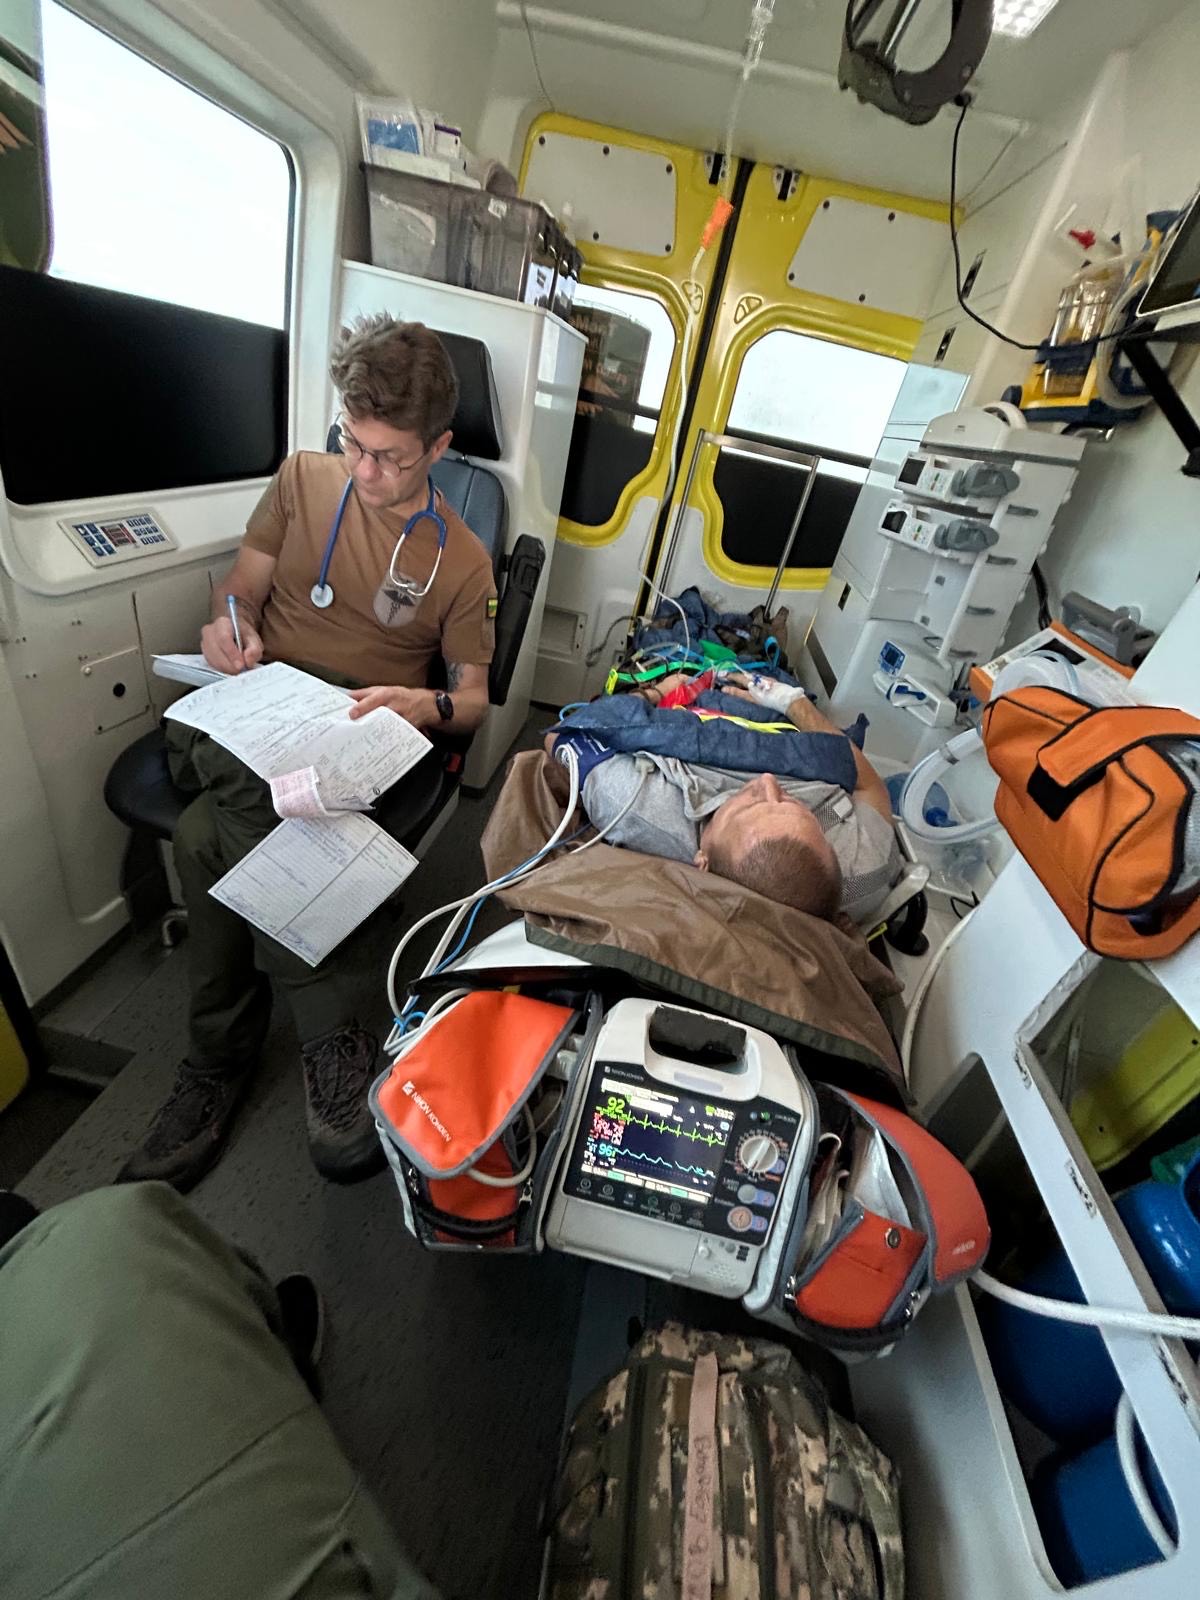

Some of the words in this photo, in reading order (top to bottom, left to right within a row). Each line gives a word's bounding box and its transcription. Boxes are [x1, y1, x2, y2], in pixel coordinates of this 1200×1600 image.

[607, 1096, 626, 1114] 92
[411, 1092, 432, 1114] NIHON
[428, 1110, 452, 1142] KOHDEN
[598, 1143, 613, 1157] 96
